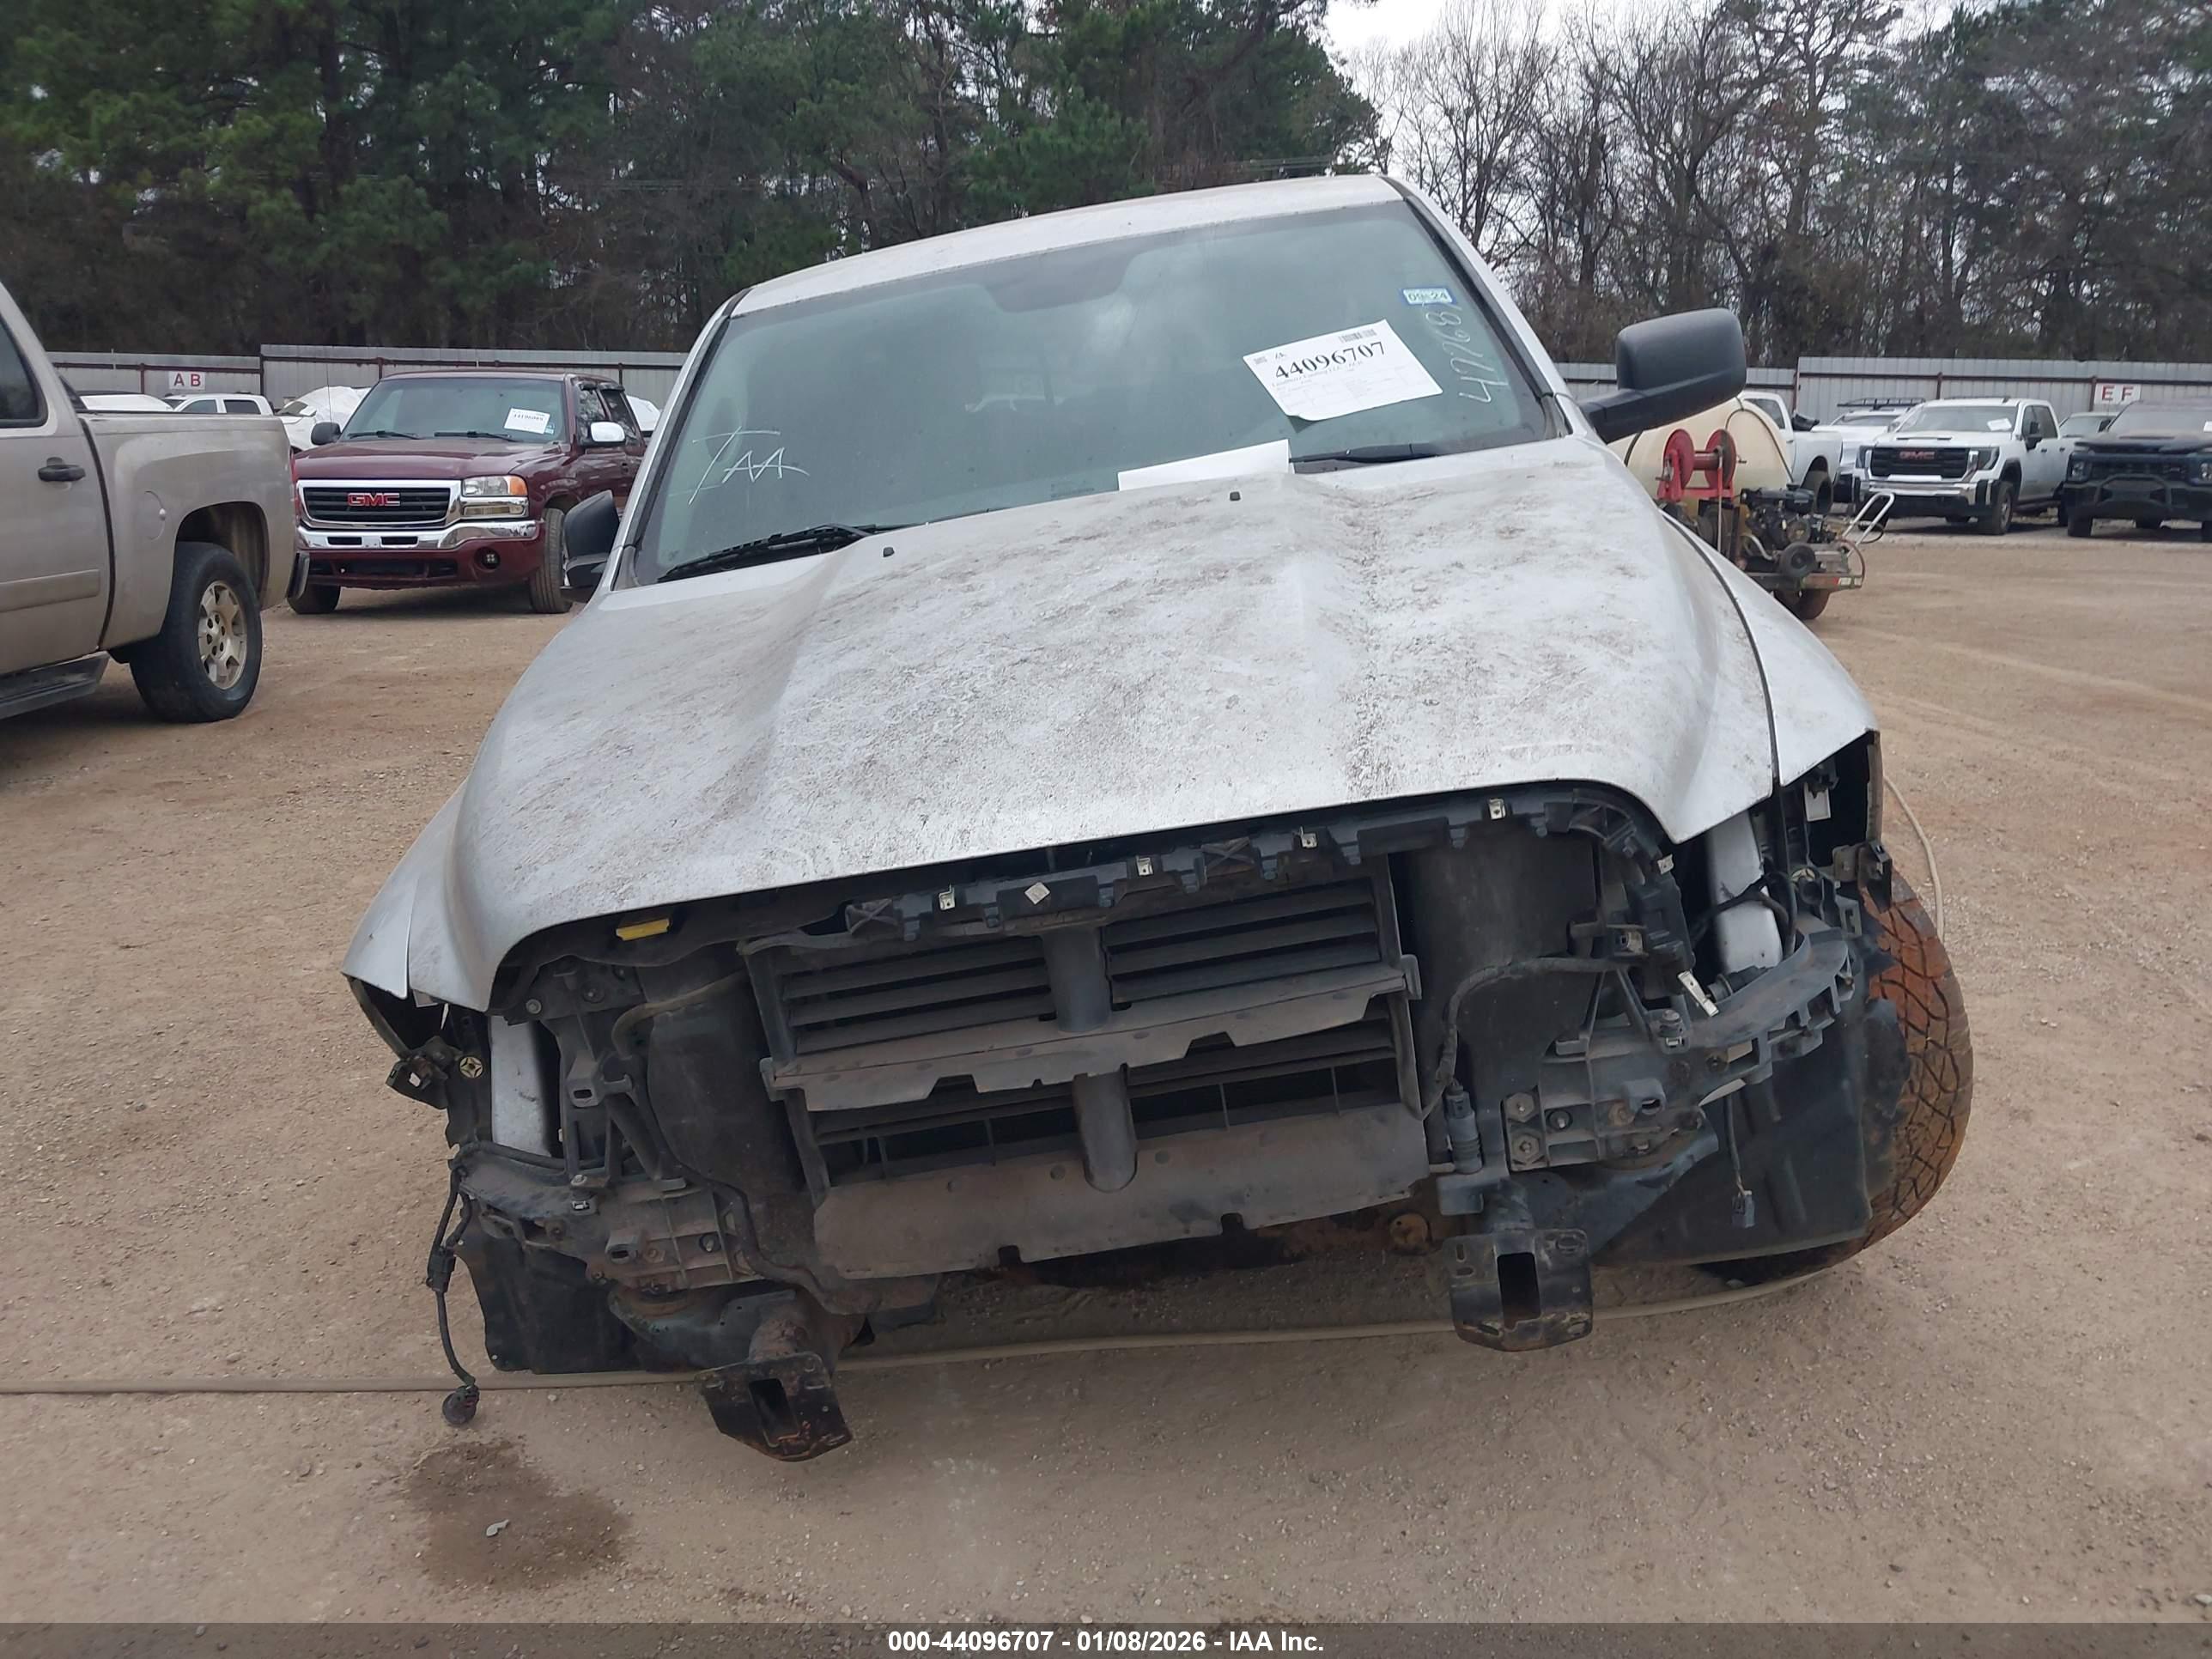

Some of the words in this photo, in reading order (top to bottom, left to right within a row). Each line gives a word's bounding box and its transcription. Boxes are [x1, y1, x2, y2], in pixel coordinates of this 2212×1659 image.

[1275, 341, 1385, 379] 44096707
[173, 373, 185, 386] A
[191, 374, 201, 386] B
[2102, 386, 2115, 400] E
[2122, 386, 2134, 401] F
[1899, 451, 1936, 459] GMC
[347, 493, 401, 507] GMC
